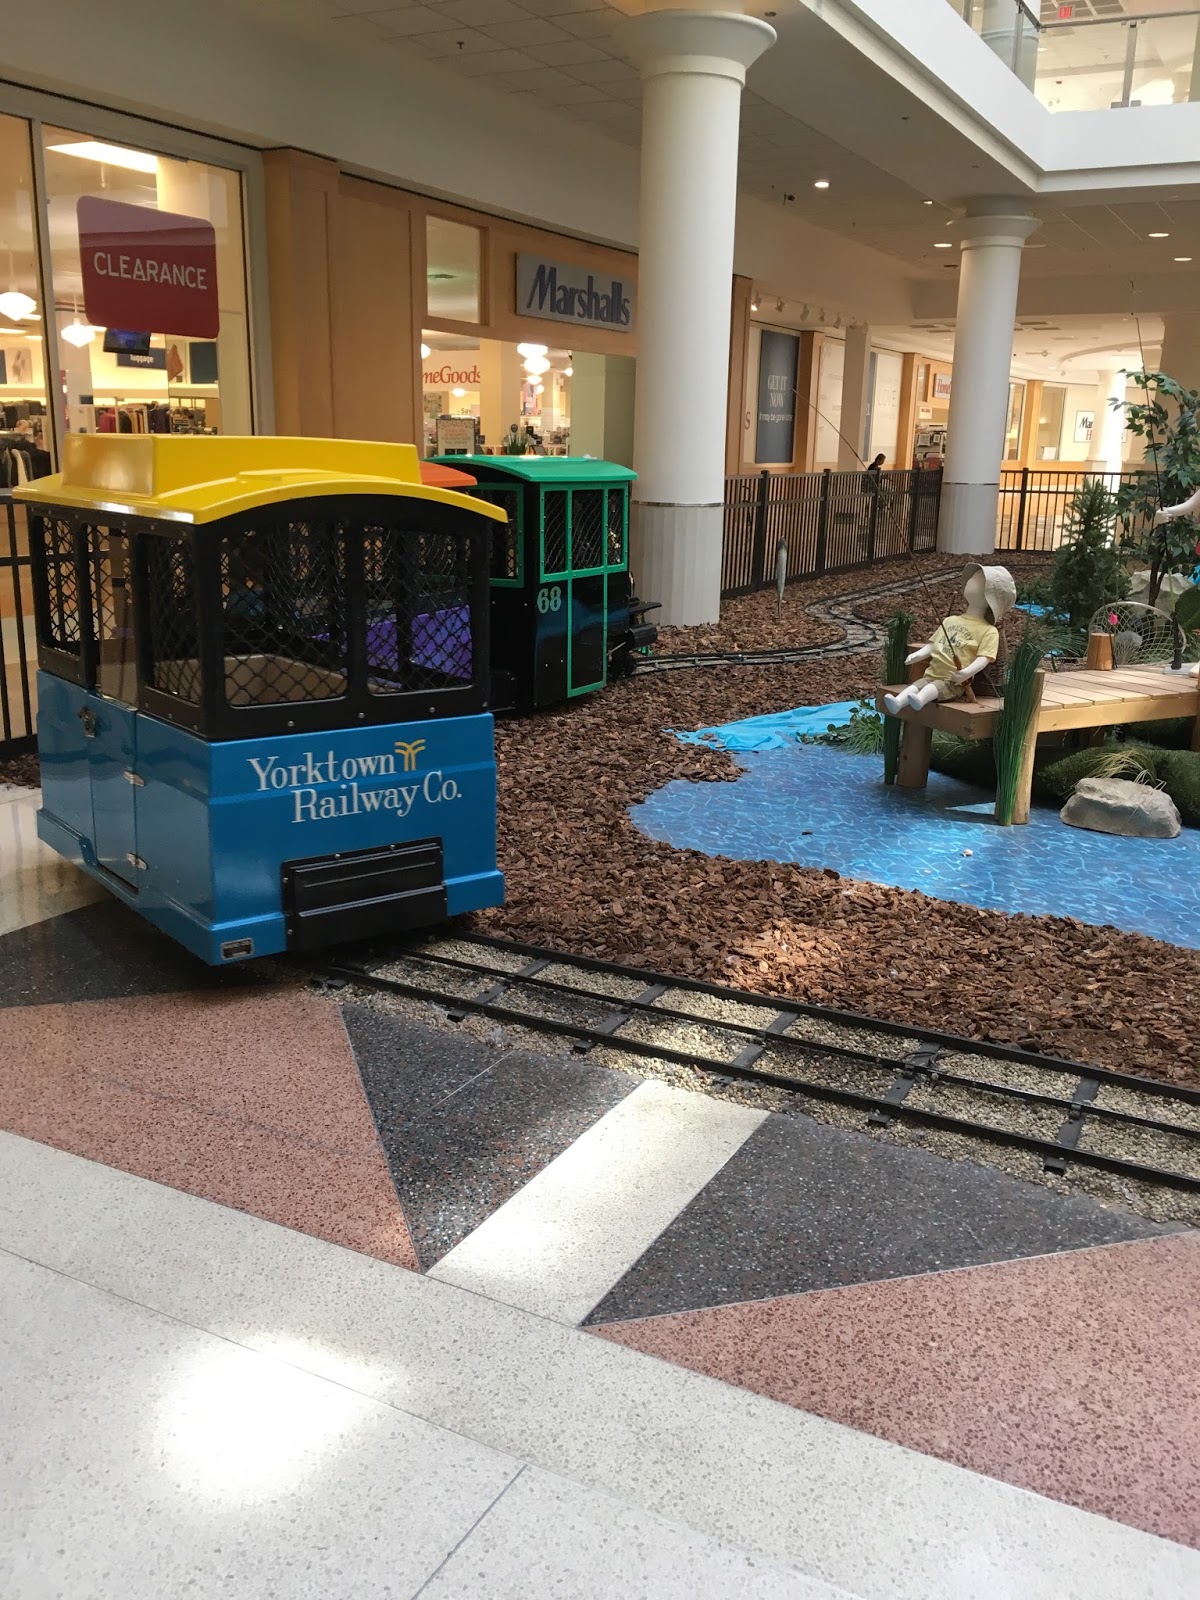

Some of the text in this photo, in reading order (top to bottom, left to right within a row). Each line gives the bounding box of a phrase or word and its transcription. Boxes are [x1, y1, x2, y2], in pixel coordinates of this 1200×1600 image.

[93, 251, 208, 290] CLEARANCE
[526, 263, 631, 326] Marshalls
[536, 585, 562, 614] 68
[246, 750, 398, 792] Yorktown
[290, 770, 463, 823] Railway Co.
